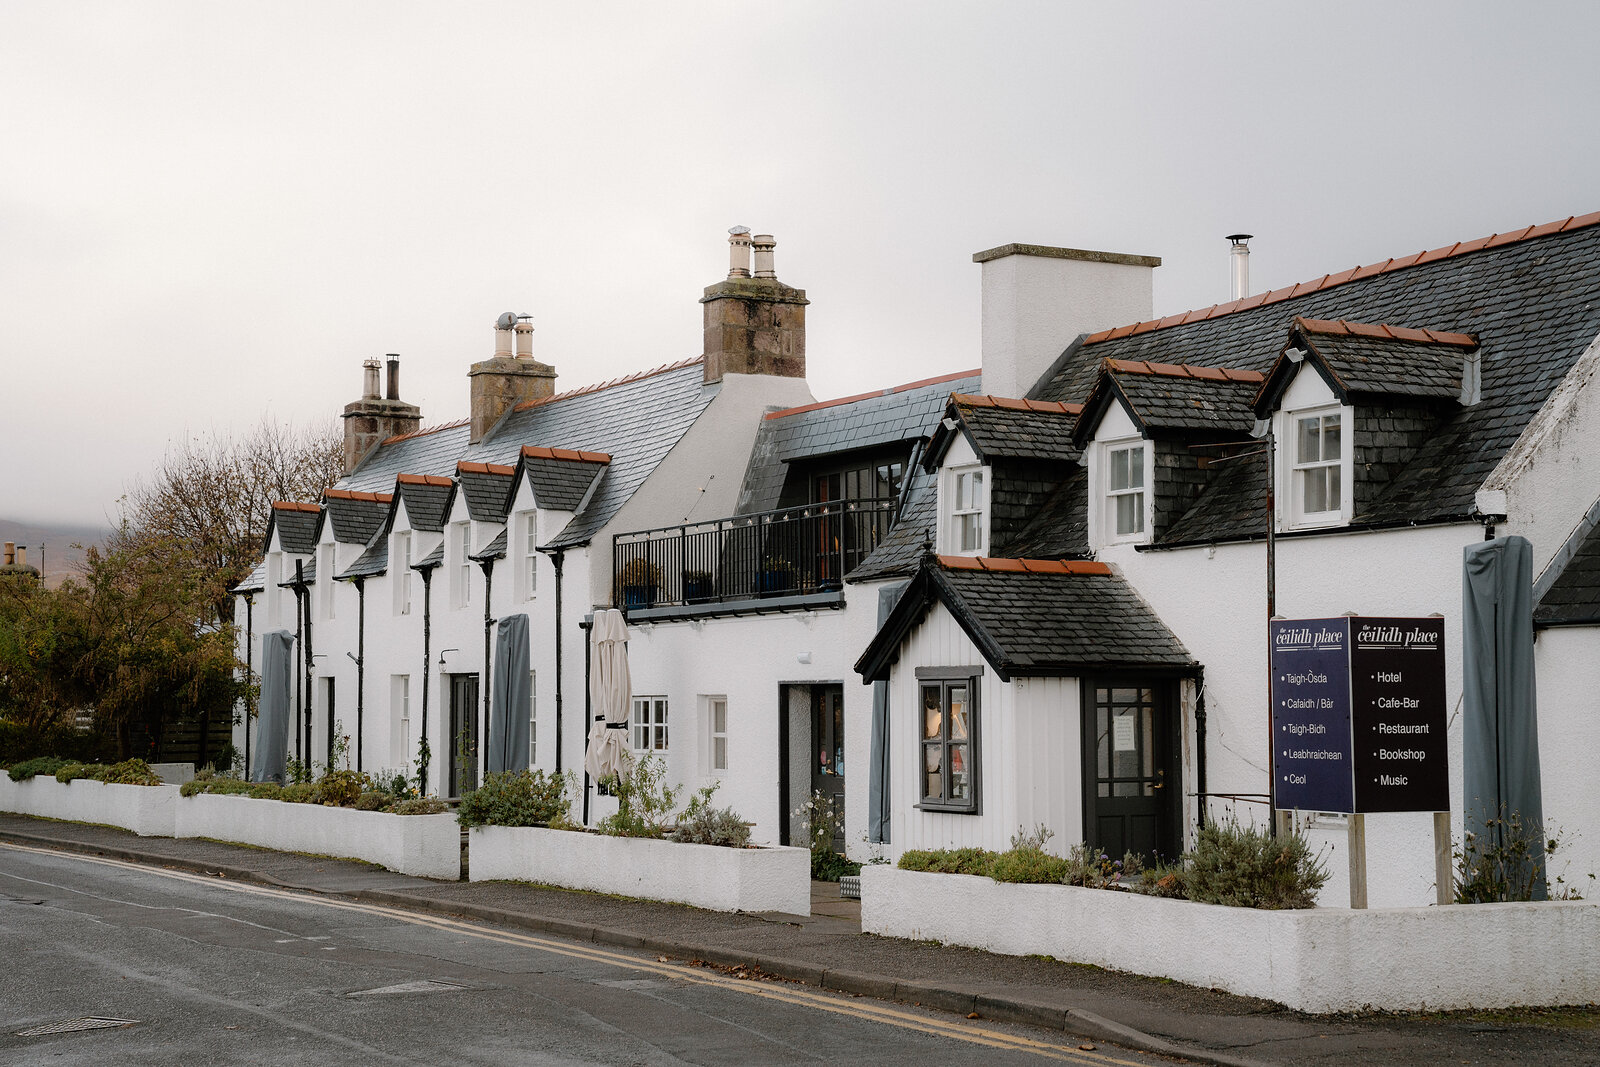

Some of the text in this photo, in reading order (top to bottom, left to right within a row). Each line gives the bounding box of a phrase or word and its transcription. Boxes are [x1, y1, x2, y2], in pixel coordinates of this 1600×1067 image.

[1276, 628, 1342, 647] ceilidh place
[1358, 627, 1437, 646] ceilidh place
[1286, 670, 1327, 685] Taigh-Òsda
[1377, 672, 1401, 683] Hotel
[1287, 699, 1315, 708] Cafaidh
[1321, 698, 1334, 708] Bàr
[1378, 698, 1419, 708] Cafe-Bar
[1288, 724, 1325, 735] Taigh-Bidh
[1379, 723, 1429, 734] Restaurant
[1289, 749, 1342, 759] Leabhraichean
[1380, 749, 1425, 761] Bookshop
[1290, 774, 1306, 784] Ceol
[1380, 775, 1408, 785] Music
